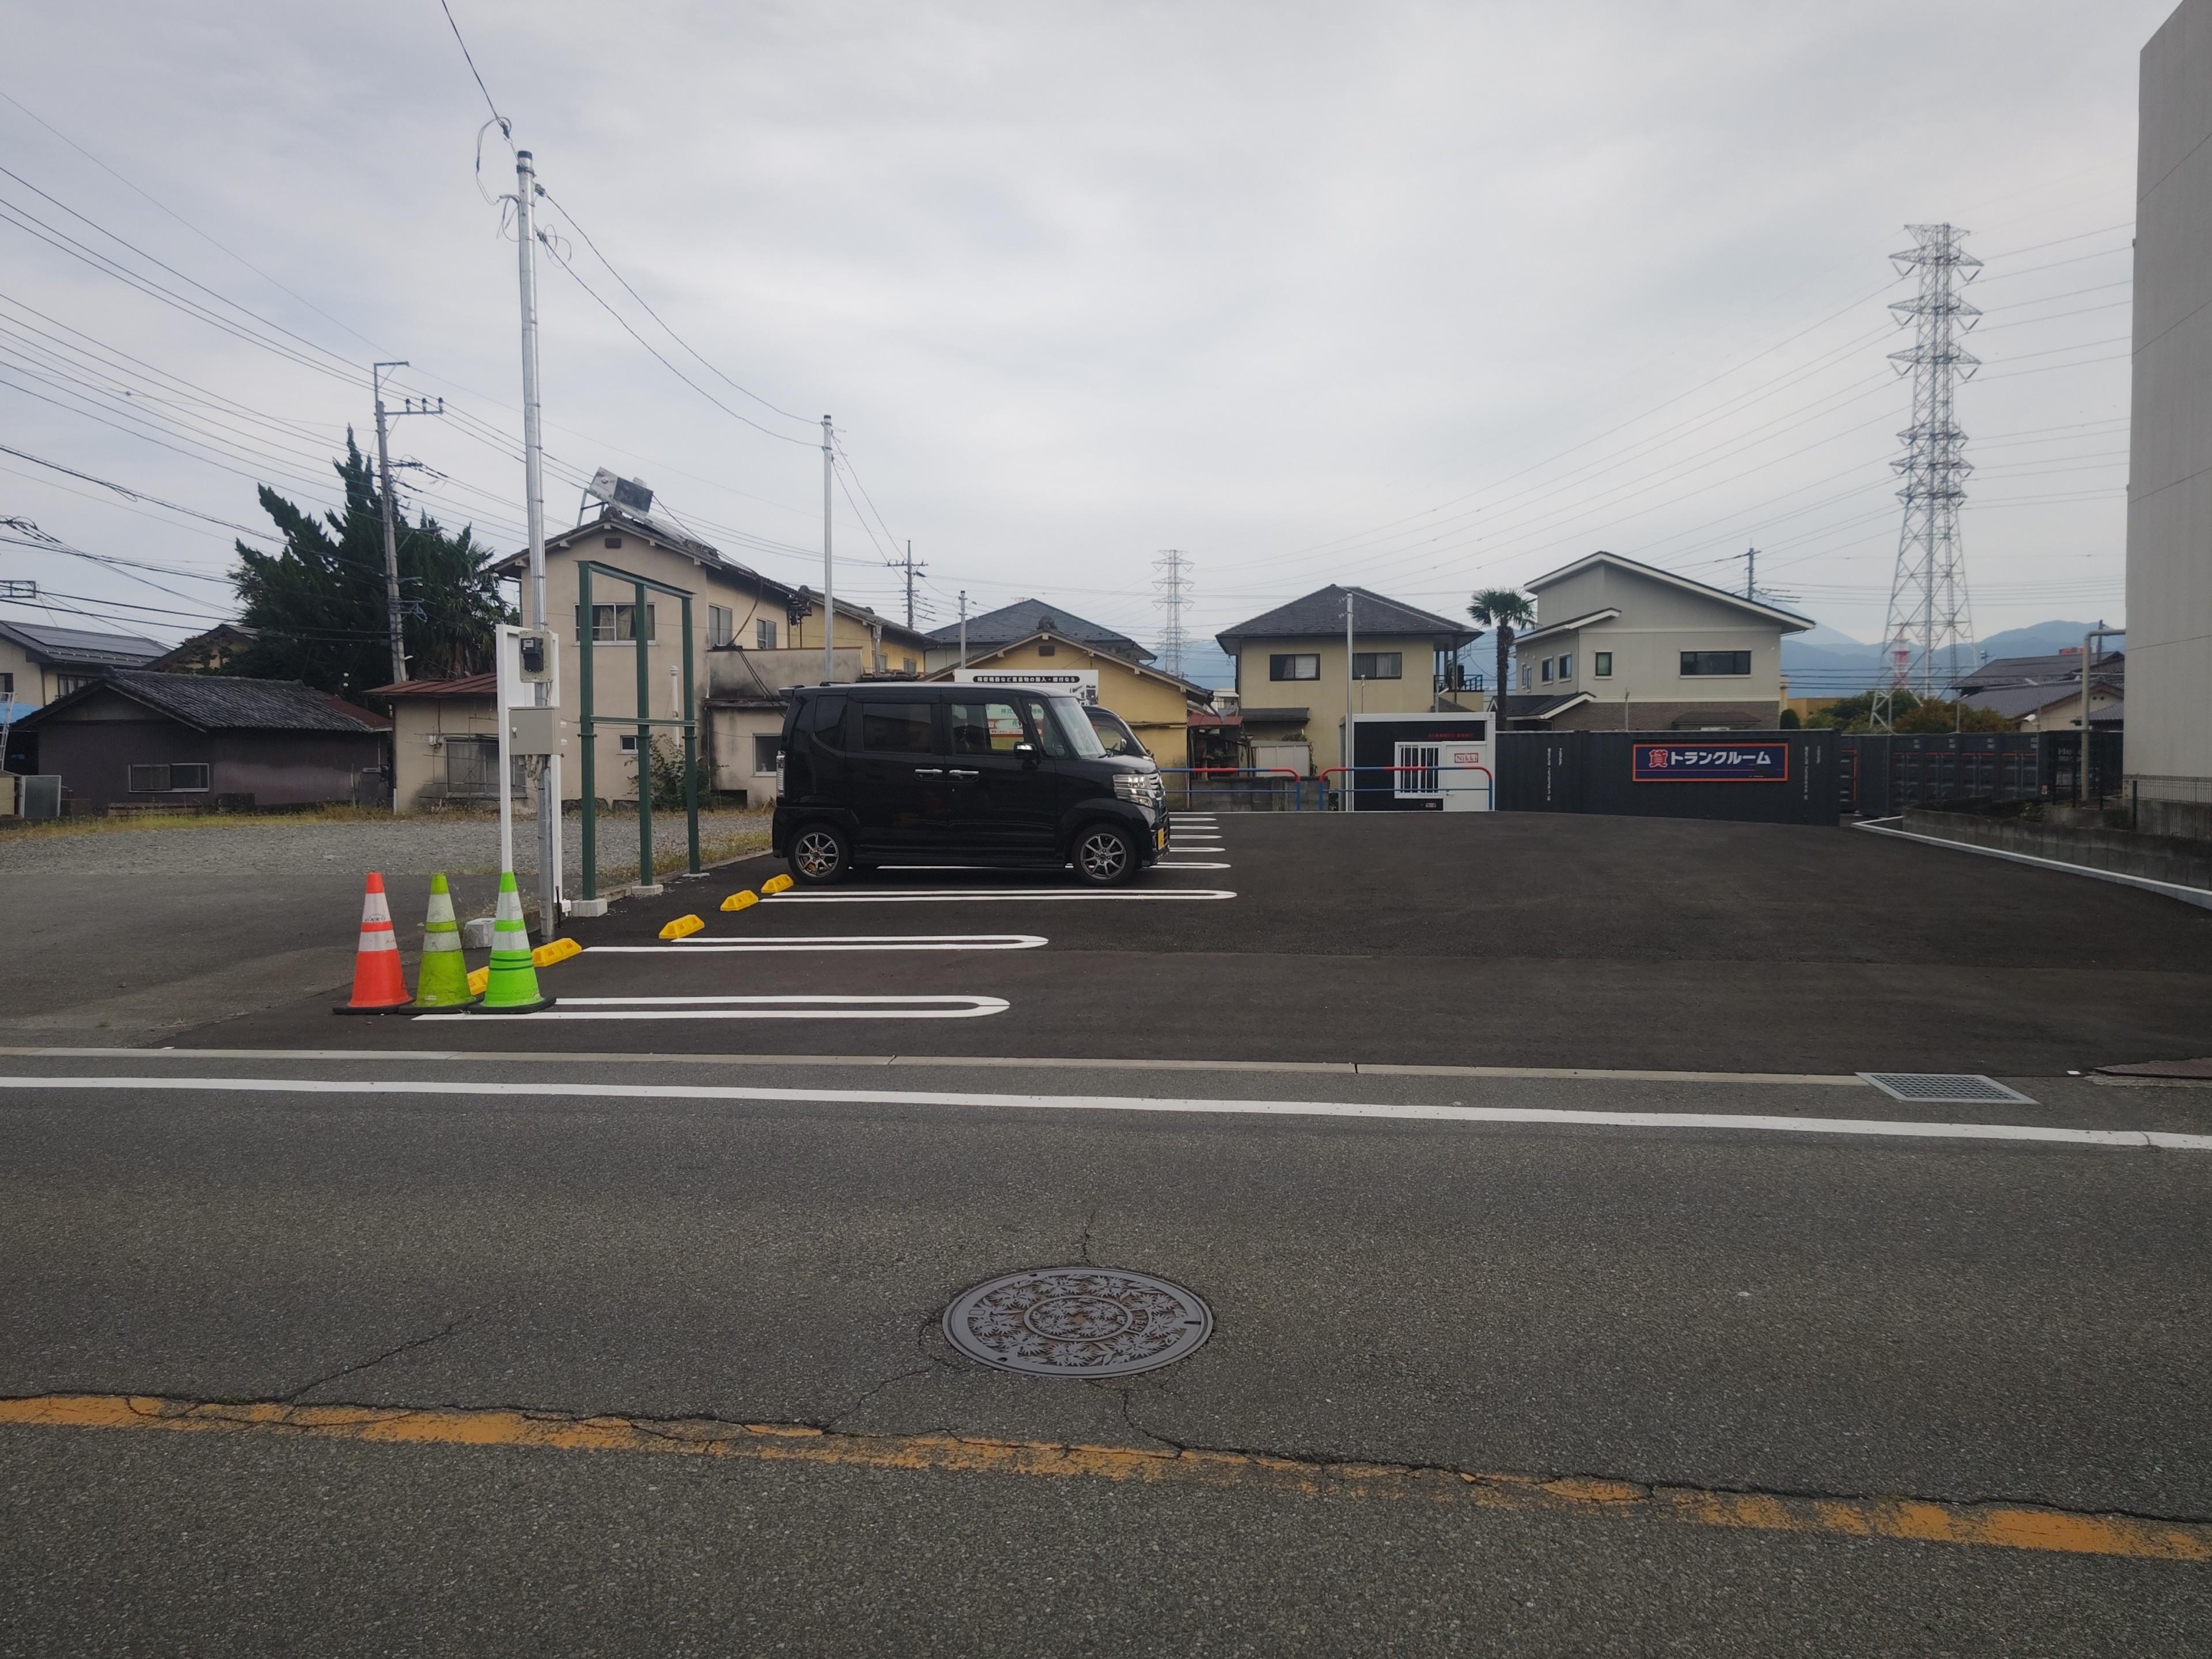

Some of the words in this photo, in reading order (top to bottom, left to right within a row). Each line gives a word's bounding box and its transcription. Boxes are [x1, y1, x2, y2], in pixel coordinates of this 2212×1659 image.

[1649, 749, 1771, 768] 貸トランクルーム
